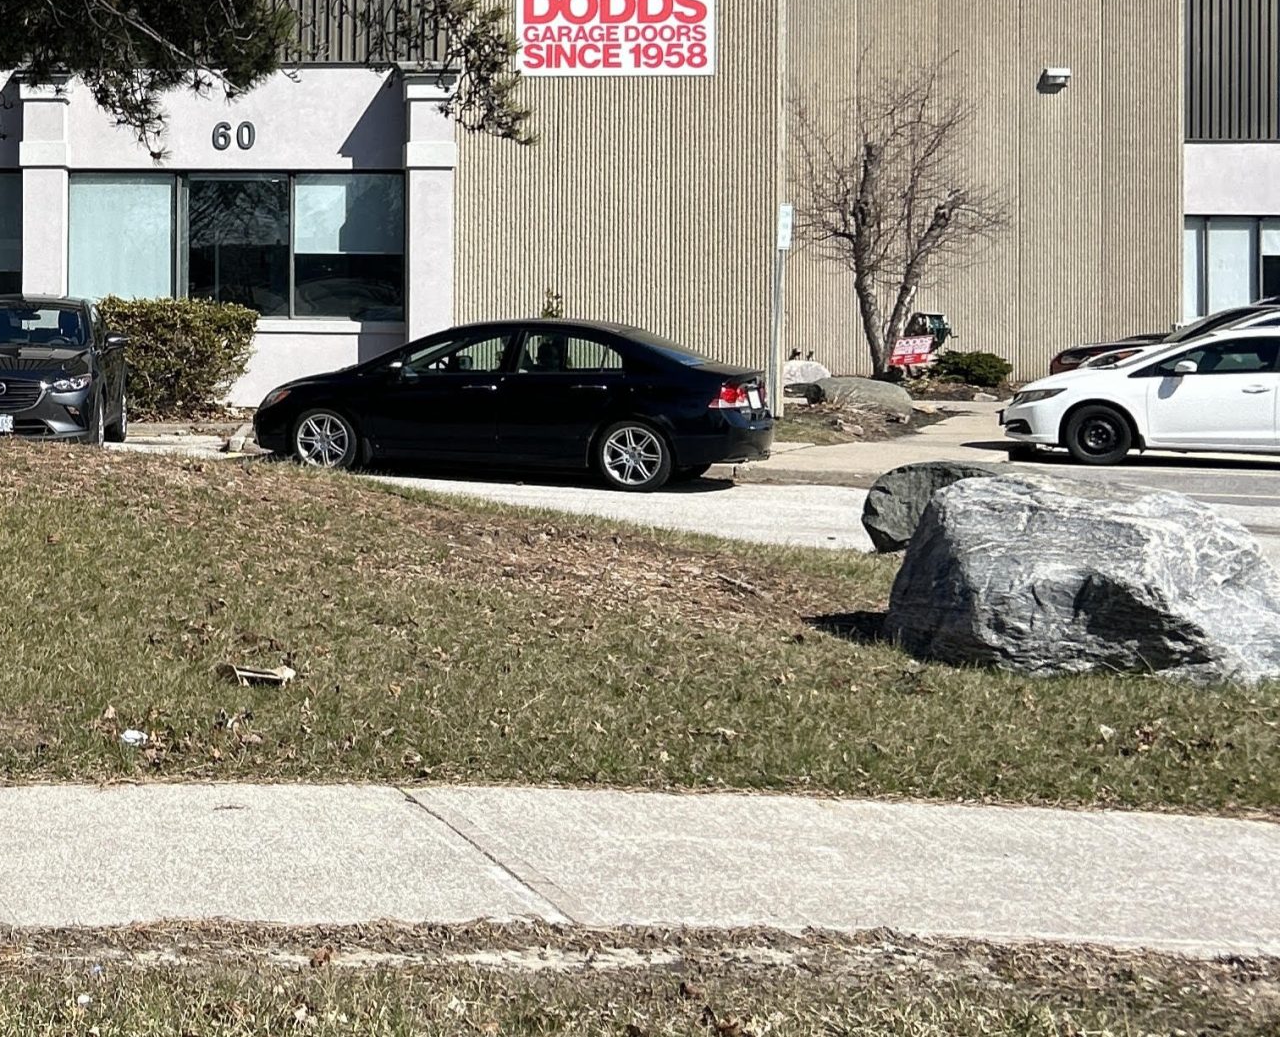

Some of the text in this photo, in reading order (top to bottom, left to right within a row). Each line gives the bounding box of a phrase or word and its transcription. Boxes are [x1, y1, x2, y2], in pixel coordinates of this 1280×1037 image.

[523, 25, 707, 43] GARAGE DOORS
[523, 43, 708, 69] SINCE 1958
[211, 120, 256, 151] 60
